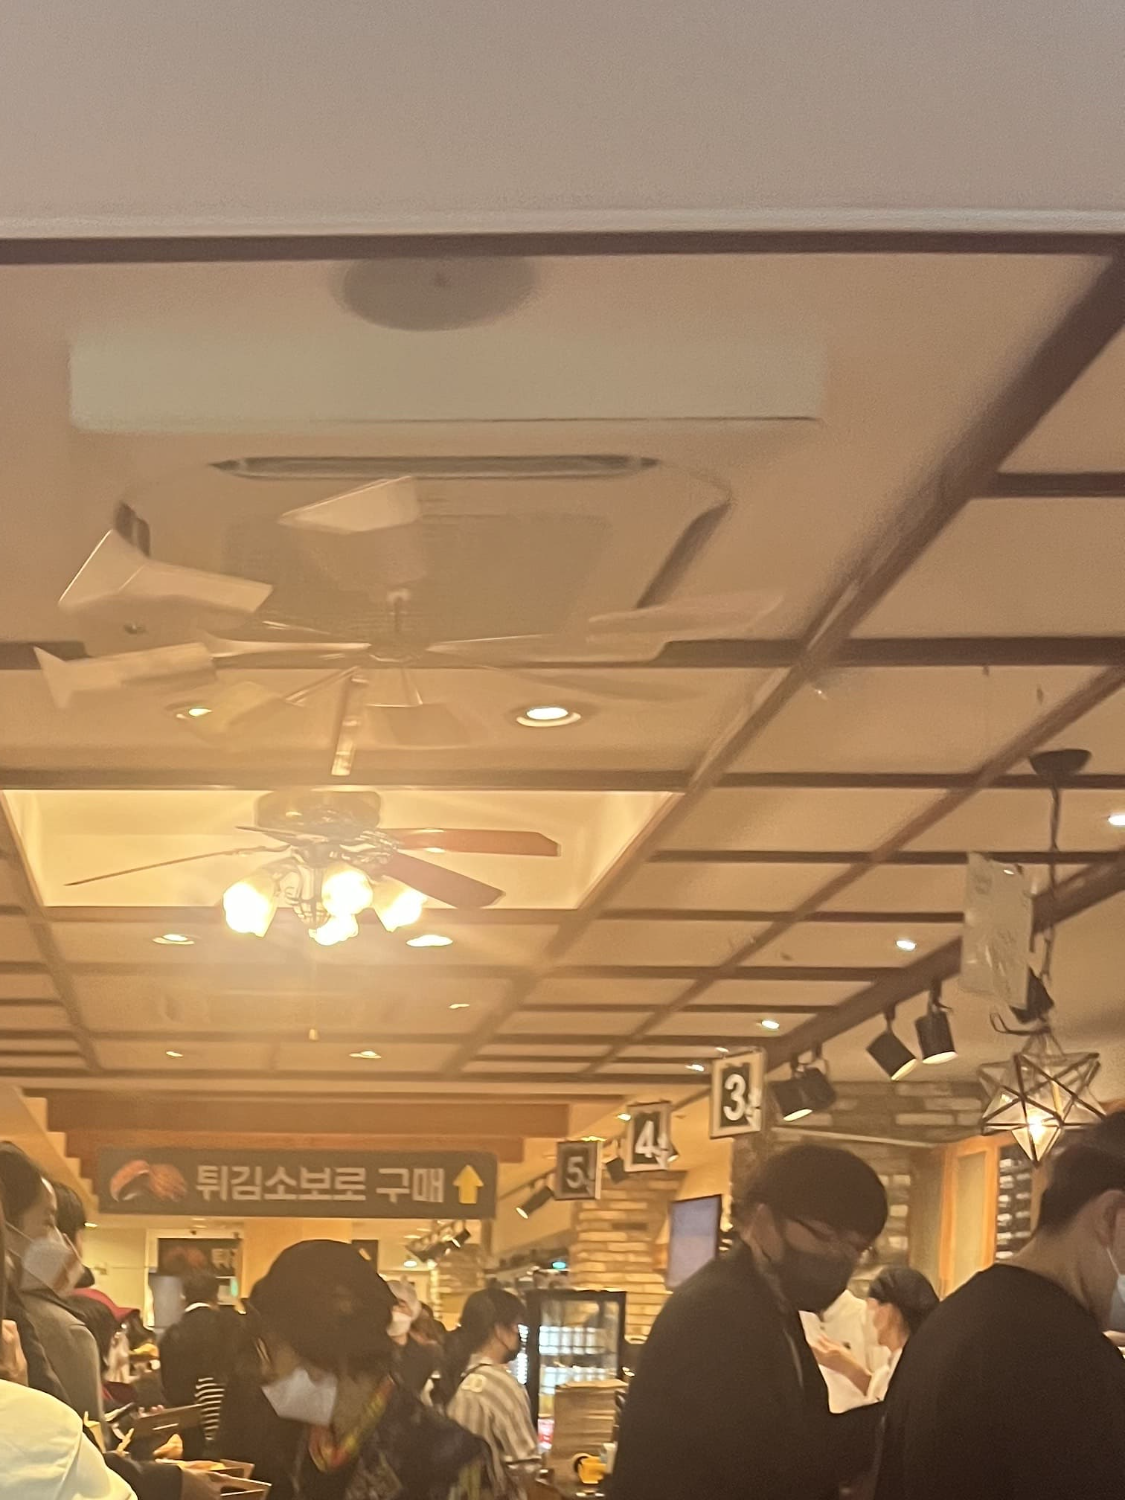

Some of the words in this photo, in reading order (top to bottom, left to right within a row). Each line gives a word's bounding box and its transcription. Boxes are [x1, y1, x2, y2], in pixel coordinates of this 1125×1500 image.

[723, 1074, 746, 1121] 3
[635, 1120, 658, 1158] 4
[196, 1164, 367, 1202] 튀김소보로
[376, 1166, 445, 1204] 구매
[566, 1156, 584, 1189] 5
